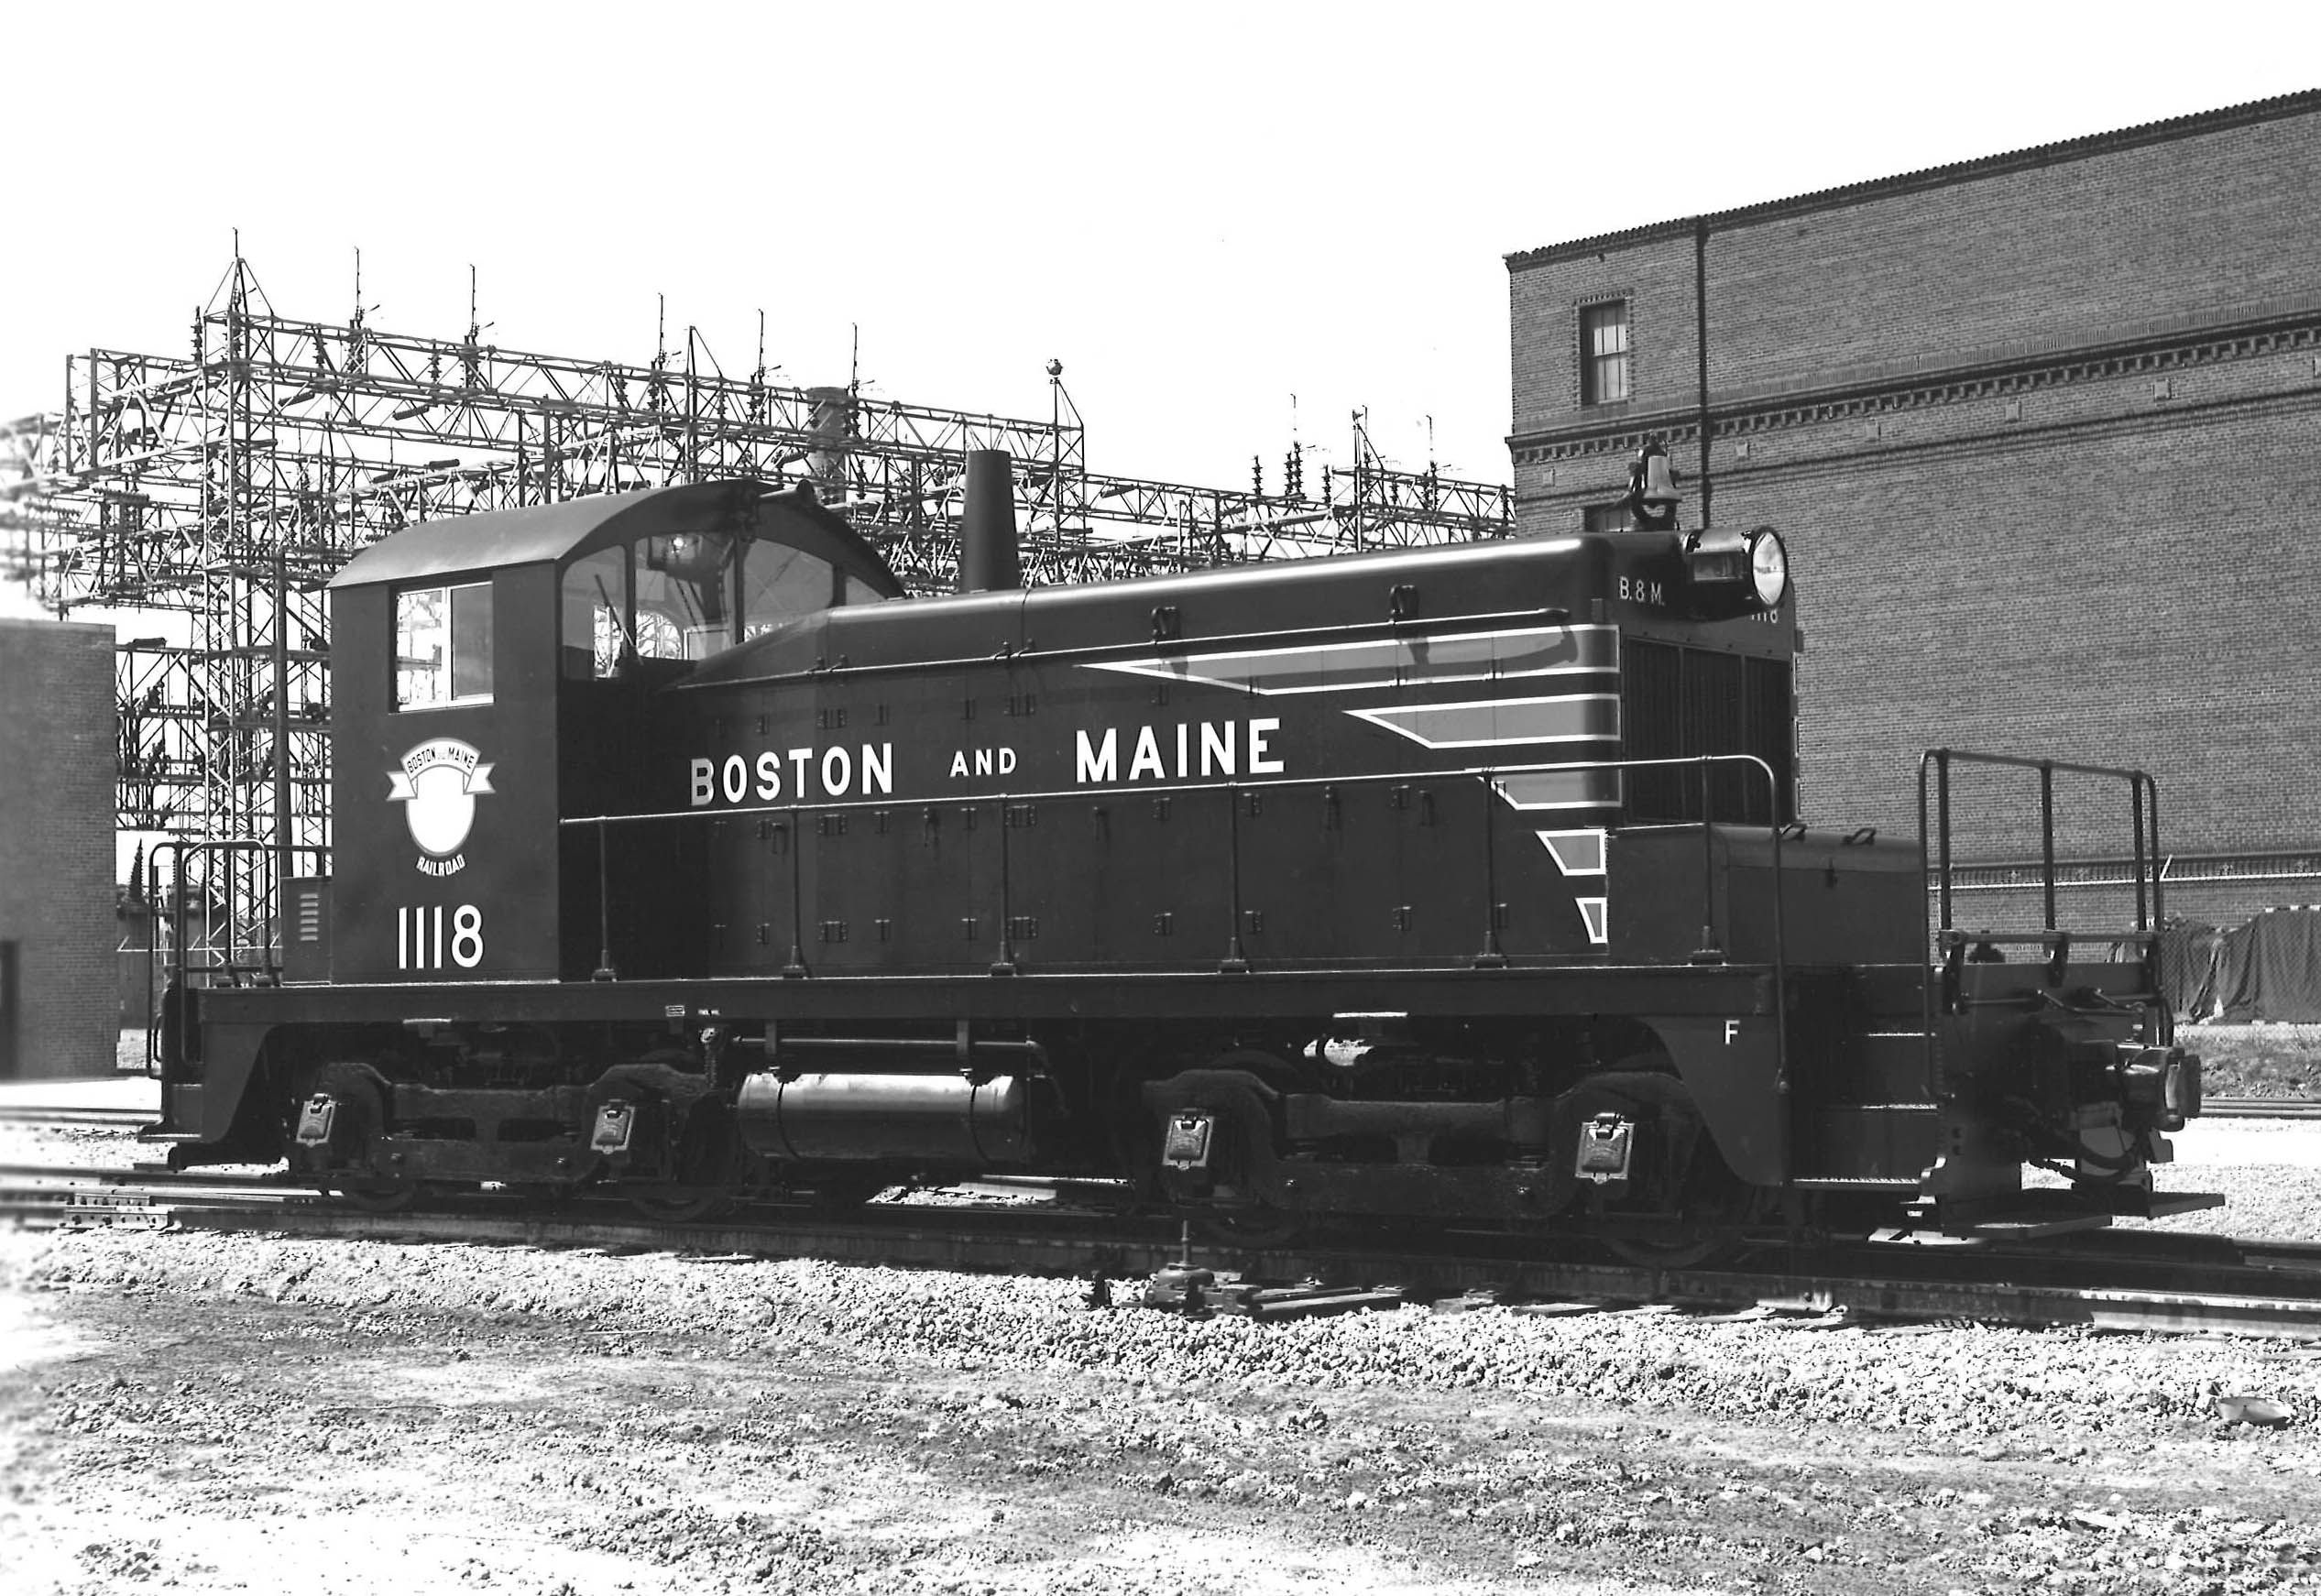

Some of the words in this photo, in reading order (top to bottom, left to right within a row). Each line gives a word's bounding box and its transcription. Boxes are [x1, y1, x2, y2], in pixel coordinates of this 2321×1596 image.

[407, 747, 435, 773] BOSTON
[448, 747, 475, 770] MAINE
[691, 742, 892, 807] BOSTON
[949, 747, 1017, 778] AND
[1076, 717, 1285, 783] MAINE
[415, 853, 466, 877] RAILROAD
[398, 903, 485, 969] 1118
[1724, 1019, 1740, 1045] F
